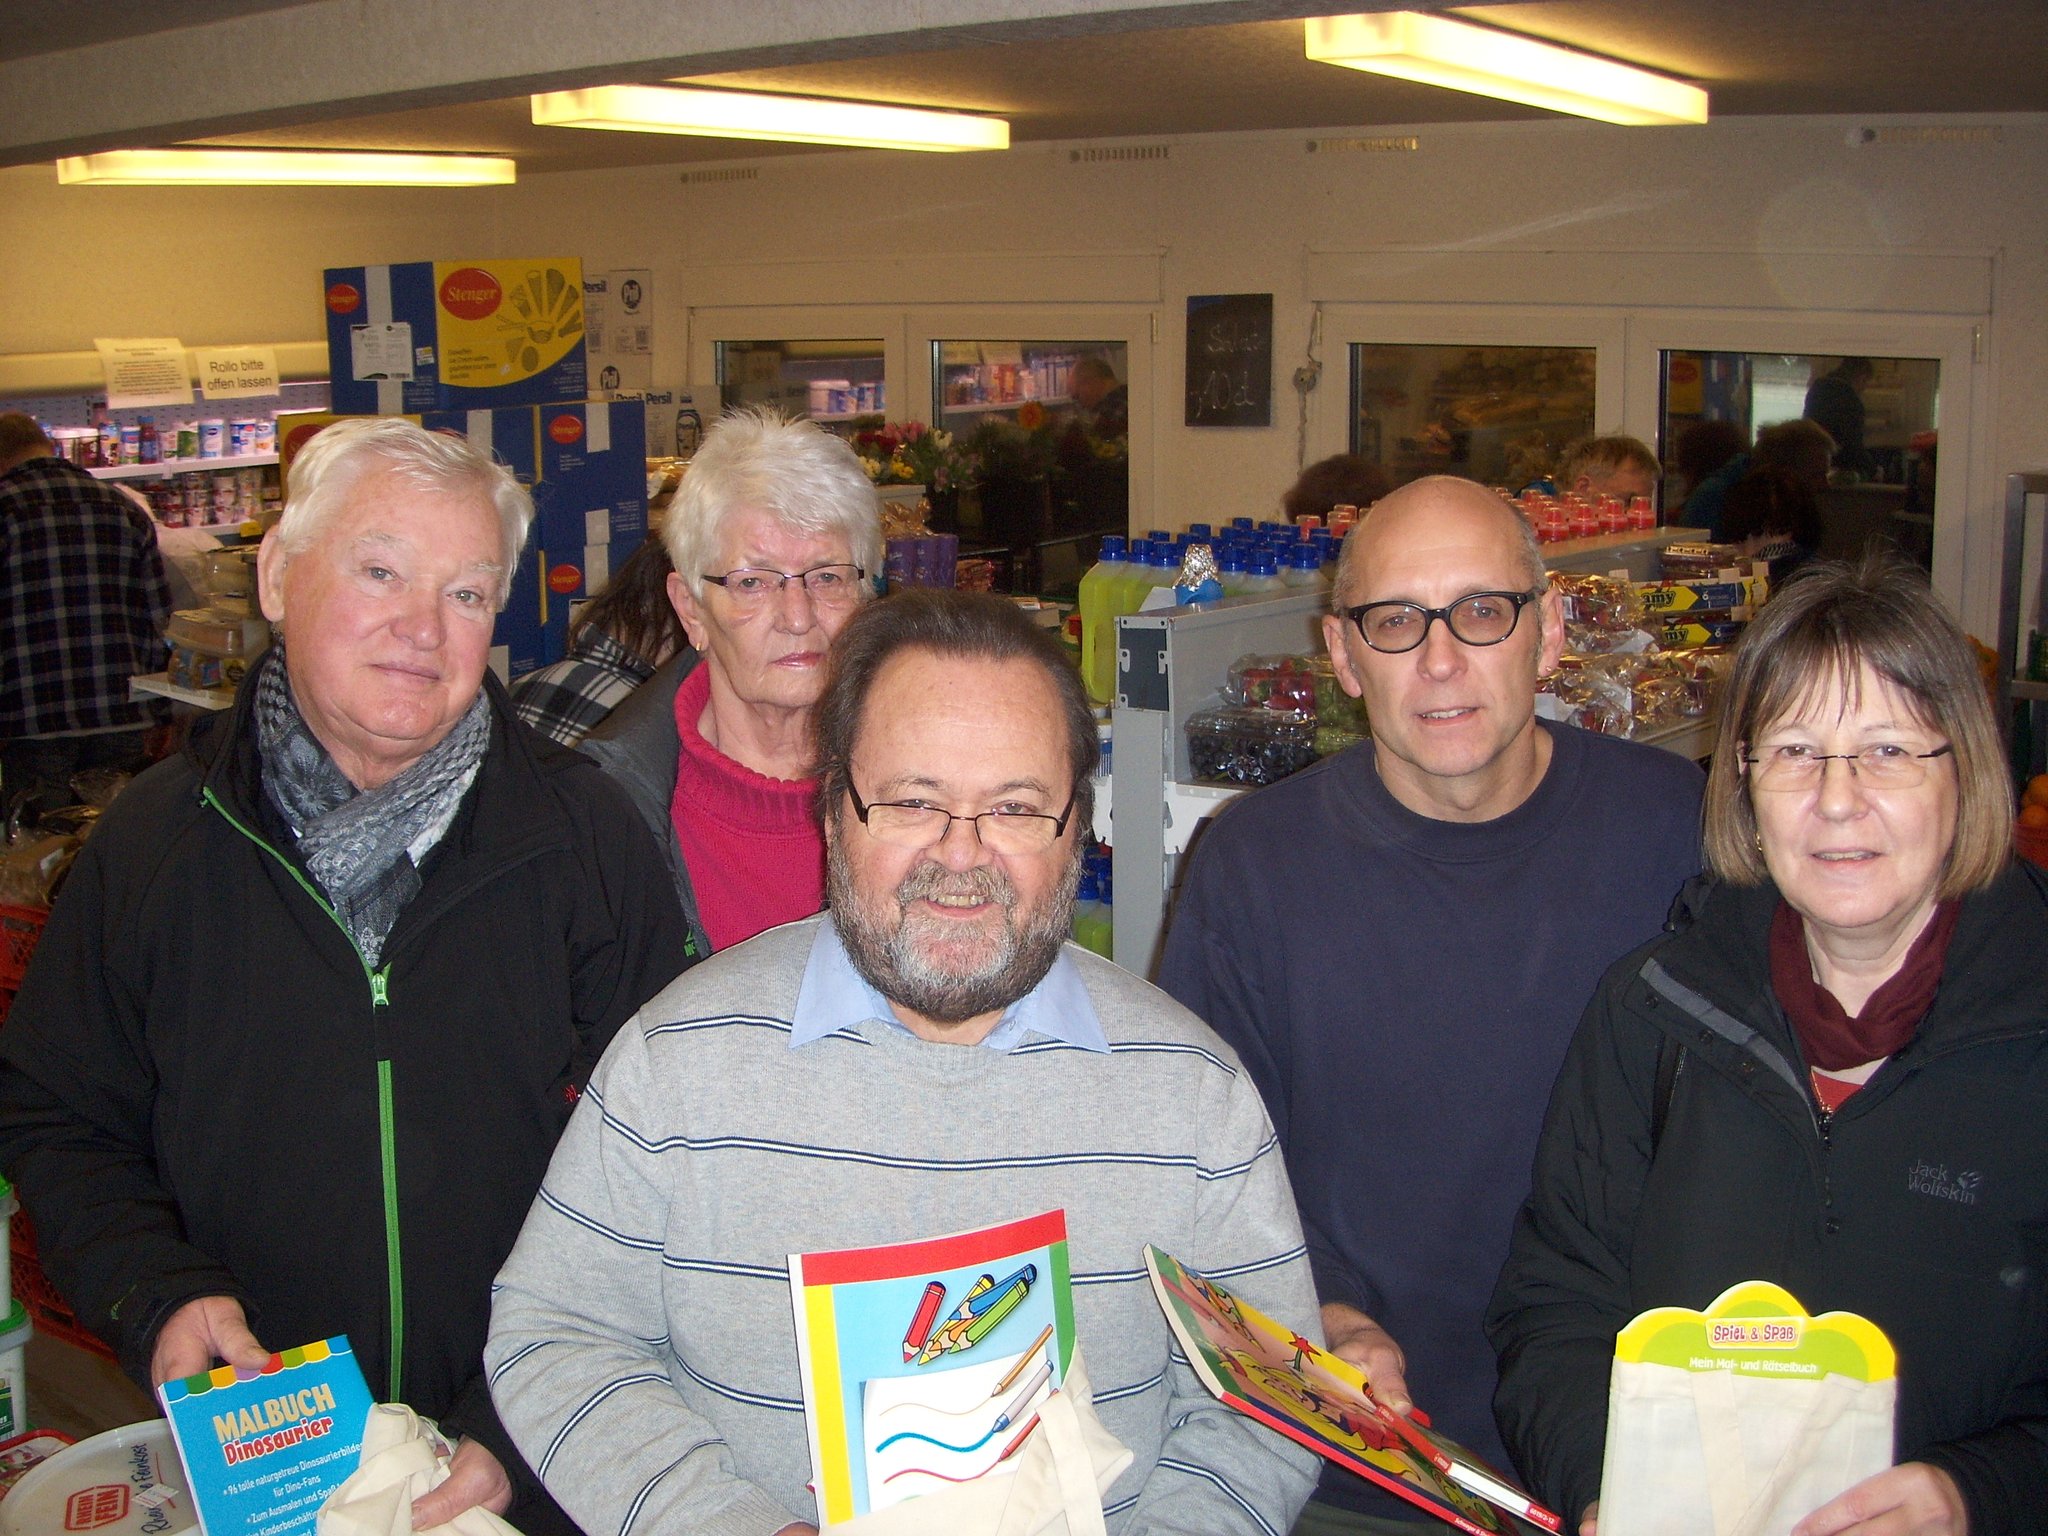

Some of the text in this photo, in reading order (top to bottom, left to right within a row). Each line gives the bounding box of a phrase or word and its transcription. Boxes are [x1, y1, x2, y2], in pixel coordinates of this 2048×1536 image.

[447, 287, 498, 304] Stenger
[209, 359, 264, 373] Rollo bitte
[207, 376, 273, 391] offen lassen
[646, 391, 672, 404] Persil
[1909, 1159, 1947, 1181] Jack
[1908, 1174, 1975, 1205] Wolfskin
[1713, 1324, 1794, 1341] Spiel & Spaß
[1689, 1357, 1817, 1373] Mein Mal- und Rätselbuch
[212, 1383, 336, 1444] MALBUCH
[222, 1415, 334, 1467] Dinosaurier
[128, 1443, 153, 1482] Feinkost
[227, 1484, 238, 1495] 96
[238, 1480, 254, 1492] tolle
[255, 1464, 299, 1486] naturgetreue
[273, 1474, 321, 1499] für Dino-Fans
[76, 1494, 95, 1525] RHEIN
[95, 1489, 119, 1521] FEIN
[250, 1510, 269, 1523] Zum
[268, 1499, 304, 1517] Ausmalen
[303, 1491, 318, 1504] und
